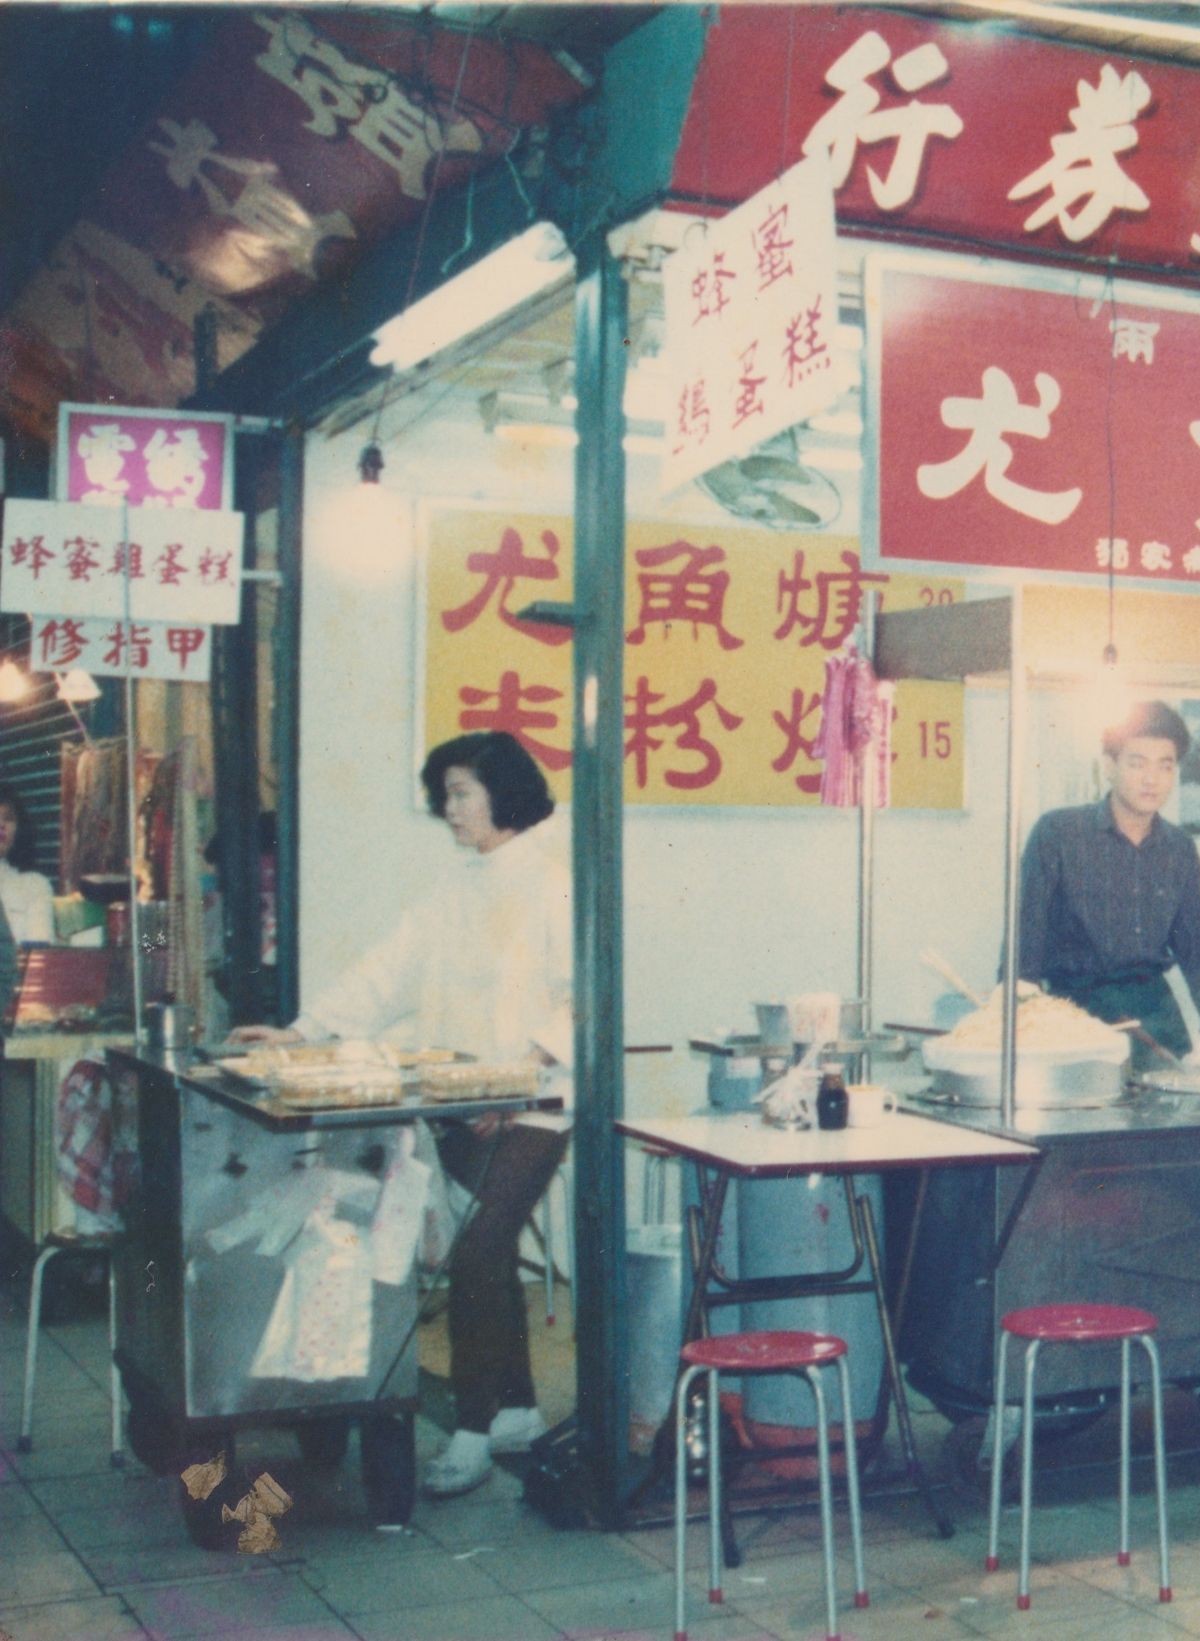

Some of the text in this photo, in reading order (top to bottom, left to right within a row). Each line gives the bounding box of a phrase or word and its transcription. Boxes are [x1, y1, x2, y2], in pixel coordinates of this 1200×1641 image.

[38, 618, 205, 671] 修指甲
[919, 721, 952, 760] 15
